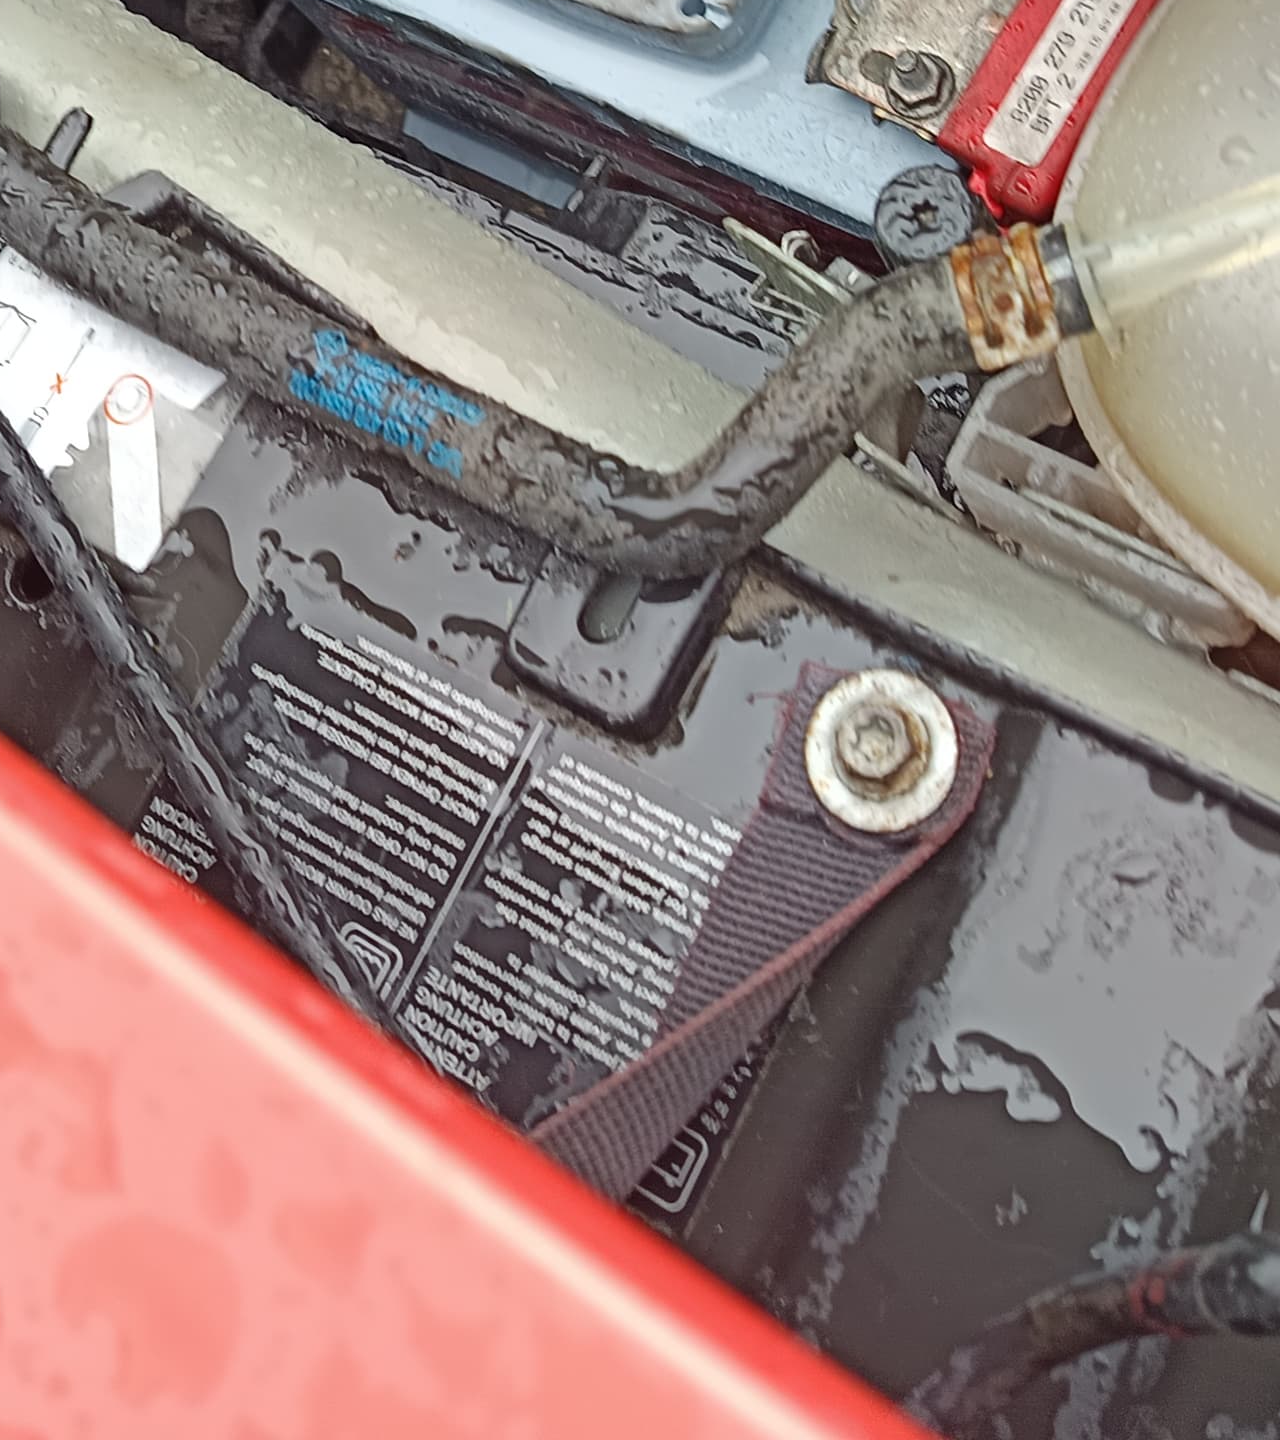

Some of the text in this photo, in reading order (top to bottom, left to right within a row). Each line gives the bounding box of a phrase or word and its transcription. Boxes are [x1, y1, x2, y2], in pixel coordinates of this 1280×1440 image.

[1057, 72, 1077, 91] 2
[429, 675, 451, 693] por
[374, 686, 420, 718] MOTOR
[419, 711, 449, 734] CON
[243, 733, 264, 750] the
[448, 728, 486, 755] ABRIR
[368, 753, 391, 772] BEI
[400, 751, 426, 771] eine
[485, 749, 508, 768] NO
[558, 754, 575, 770] el
[285, 779, 330, 811] ENGINE
[547, 762, 610, 805] cualquier
[574, 762, 633, 801] consulte
[332, 786, 359, 808] fluid
[439, 794, 479, 824] NICHT
[608, 800, 628, 816] de
[329, 805, 366, 832] WHEN
[358, 802, 405, 834] coolant
[525, 817, 551, 839] der
[683, 823, 699, 839] la
[141, 815, 216, 869] ACHTUNG
[364, 827, 402, 855] OPEN
[403, 826, 433, 851] only
[519, 830, 575, 870] solange
[551, 832, 570, 847] an
[400, 848, 428, 870] NOT
[430, 845, 457, 866] Use
[568, 840, 623, 879] Eingriff
[427, 864, 448, 882] DO
[620, 869, 665, 902] jedem
[483, 875, 565, 928] intervention
[549, 895, 575, 915] the
[573, 908, 627, 945] consult
[493, 903, 634, 991] the battery whilst the
[625, 937, 674, 972] please
[450, 941, 534, 997] intervention
[505, 953, 523, 970] la
[450, 960, 504, 999] lorsque
[521, 963, 587, 1007] consulter
[410, 985, 501, 1046] ACHTUNG
[420, 966, 541, 1045] IMPORTANTE
[401, 1004, 483, 1061] CAUTION
[554, 1026, 571, 1041] la
